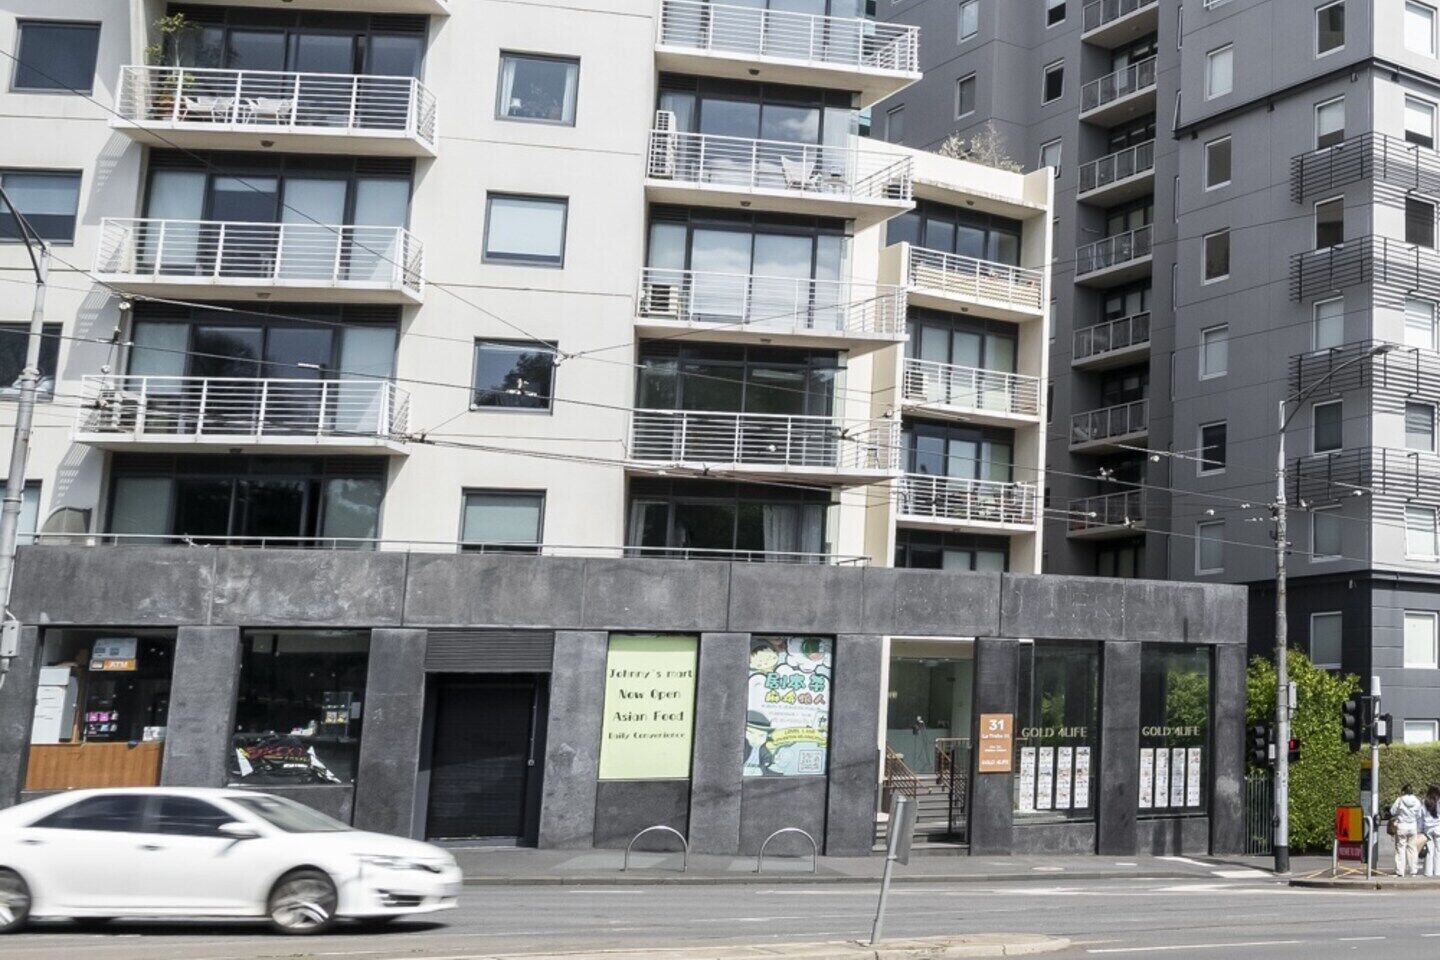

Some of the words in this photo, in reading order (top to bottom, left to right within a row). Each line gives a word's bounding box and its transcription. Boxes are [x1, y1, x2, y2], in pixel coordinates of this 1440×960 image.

[110, 660, 128, 668] ATM
[609, 669, 662, 679] Johnny's
[666, 669, 693, 679] mart
[618, 689, 644, 699] Now
[650, 689, 681, 700] Open
[612, 711, 648, 722] Asian
[653, 711, 685, 722] Food
[988, 719, 1005, 731] 31
[1021, 727, 1055, 738] GOLD
[1057, 726, 1088, 738] 4LIFE
[1141, 726, 1171, 736] GOLD
[1174, 726, 1200, 736] 4LIFE
